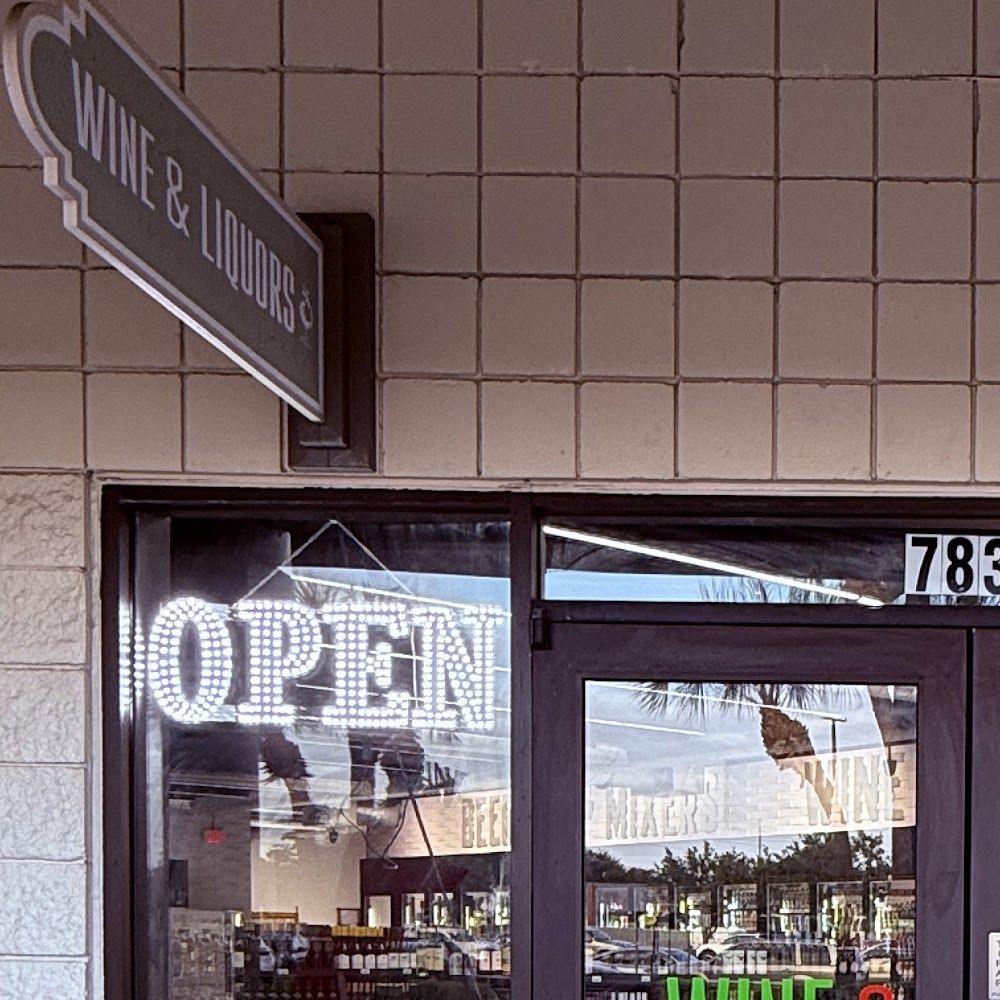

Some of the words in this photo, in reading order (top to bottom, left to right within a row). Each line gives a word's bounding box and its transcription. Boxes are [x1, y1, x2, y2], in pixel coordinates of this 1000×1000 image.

[71, 58, 155, 210] WINE
[166, 156, 190, 238] &
[201, 184, 296, 333] LIQUORS
[147, 596, 504, 730] OPEN
